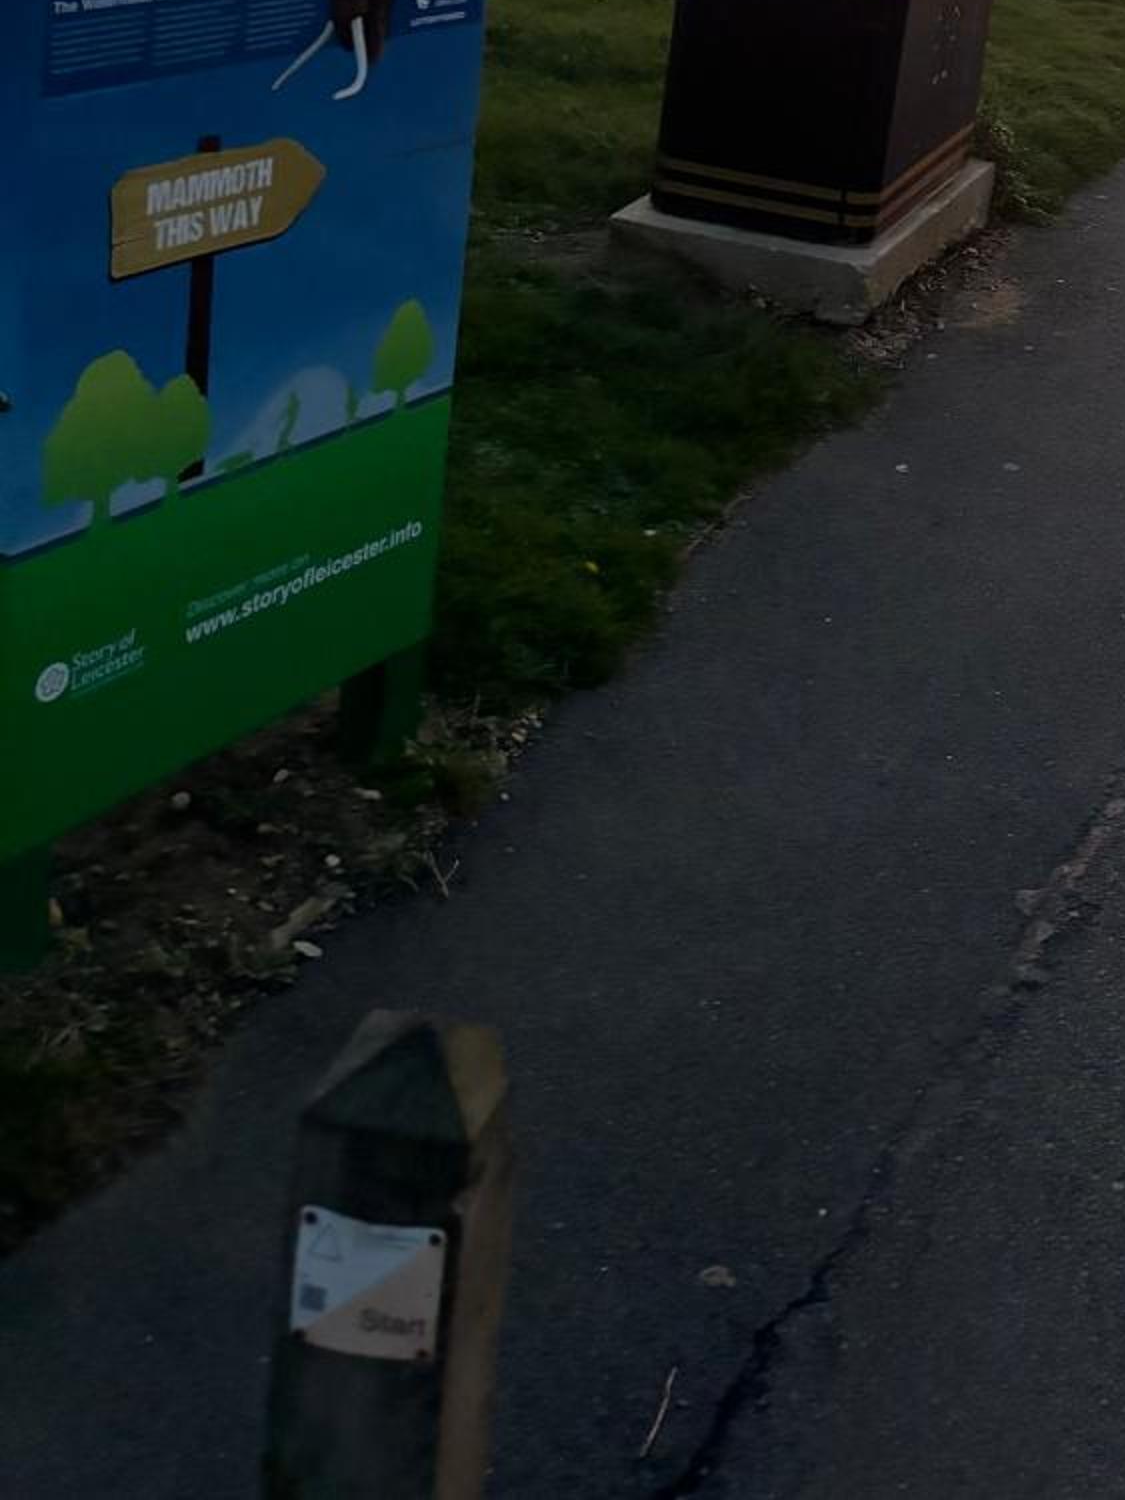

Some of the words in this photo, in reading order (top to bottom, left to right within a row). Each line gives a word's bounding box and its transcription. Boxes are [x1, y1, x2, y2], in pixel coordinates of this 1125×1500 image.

[146, 157, 274, 217] MAMMOTH
[154, 211, 204, 250] THIS
[208, 195, 264, 237] WAY
[185, 520, 423, 644] www.storyofleicester.info
